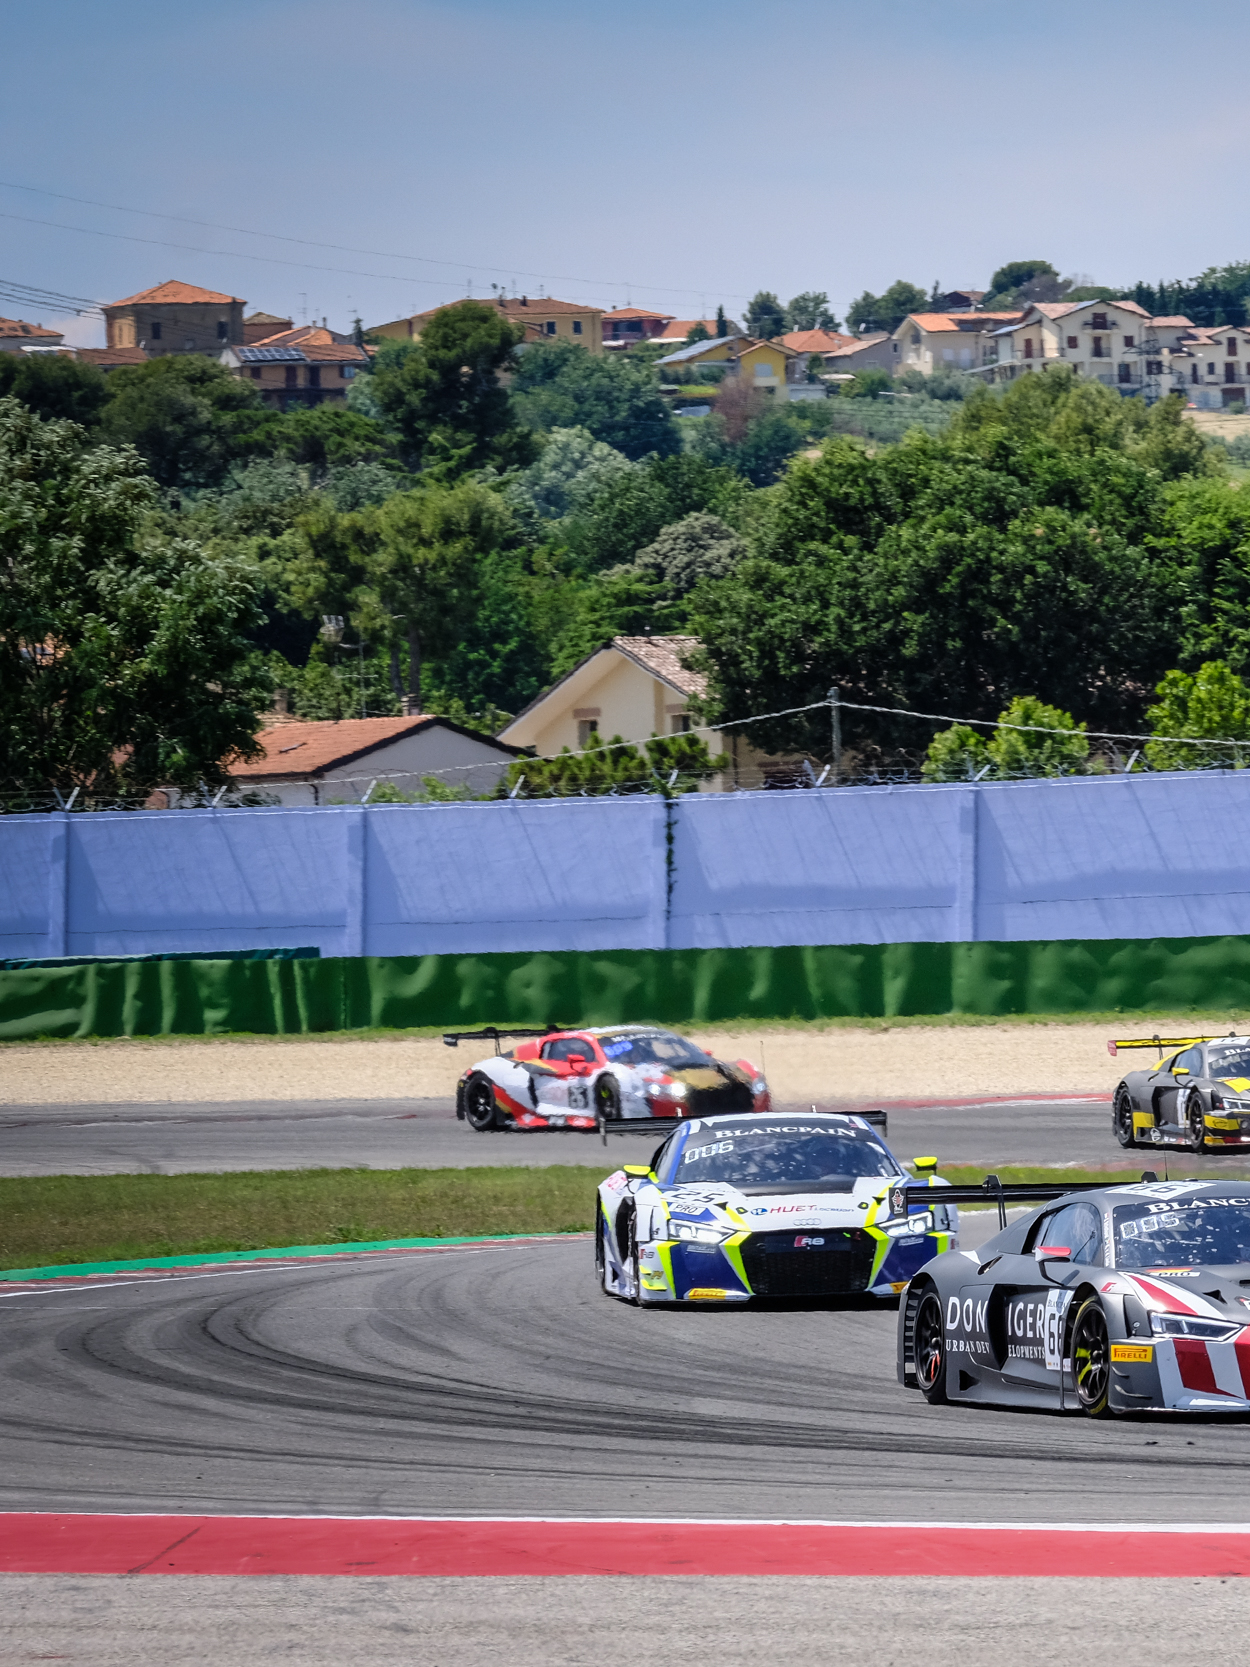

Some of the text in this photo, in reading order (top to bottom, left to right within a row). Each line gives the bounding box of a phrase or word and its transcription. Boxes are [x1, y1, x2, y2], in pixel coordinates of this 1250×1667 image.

[714, 1126, 857, 1139] BLANCPAIN
[685, 1140, 734, 1164] 006
[671, 1190, 725, 1203] 25
[673, 1204, 699, 1214] PRO
[770, 1205, 817, 1213] HUET
[945, 1339, 976, 1353] URBAN
[1113, 1348, 1148, 1360] PIRELLI
